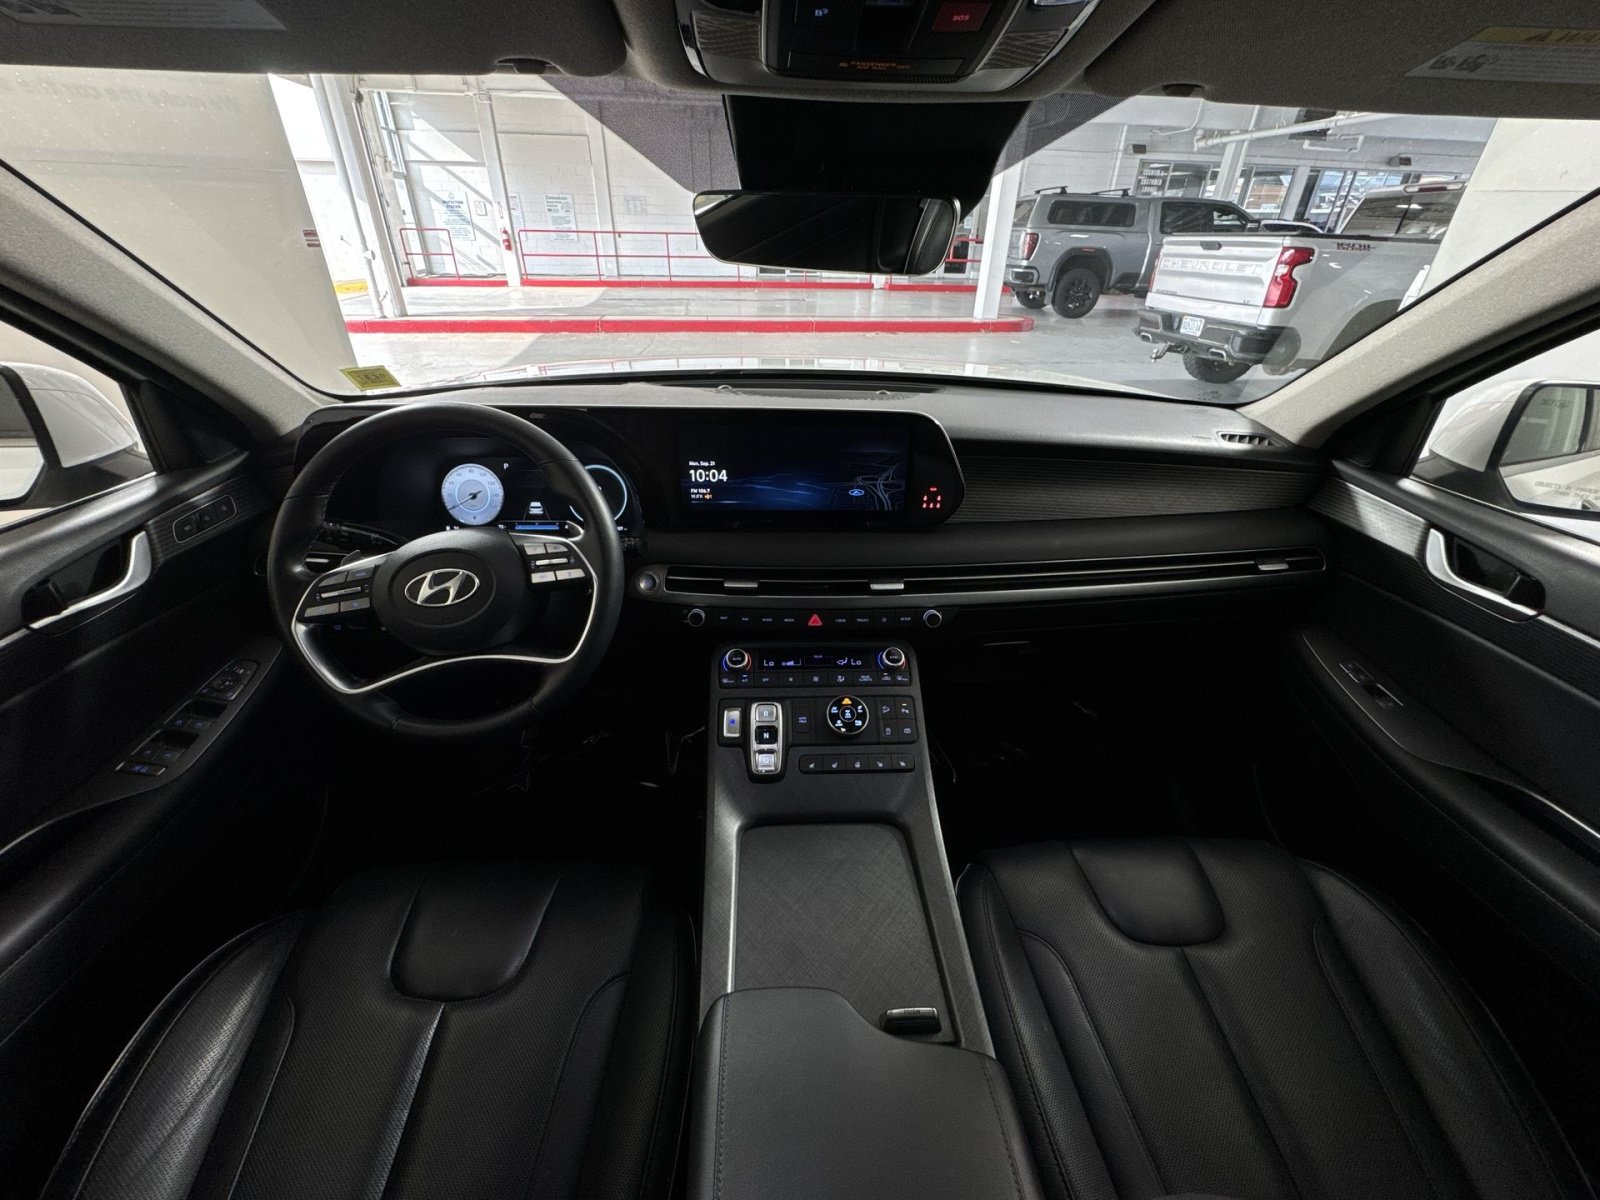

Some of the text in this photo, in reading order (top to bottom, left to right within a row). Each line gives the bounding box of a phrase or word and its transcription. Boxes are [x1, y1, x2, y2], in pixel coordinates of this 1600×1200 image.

[1140, 178, 1163, 186] CUSTOMER
[1160, 258, 1263, 275] CHEVROLET
[689, 469, 728, 482] 10:04
[1534, 480, 1562, 490] OBJECTS
[763, 659, 775, 667] Lo
[850, 658, 862, 666] Lo
